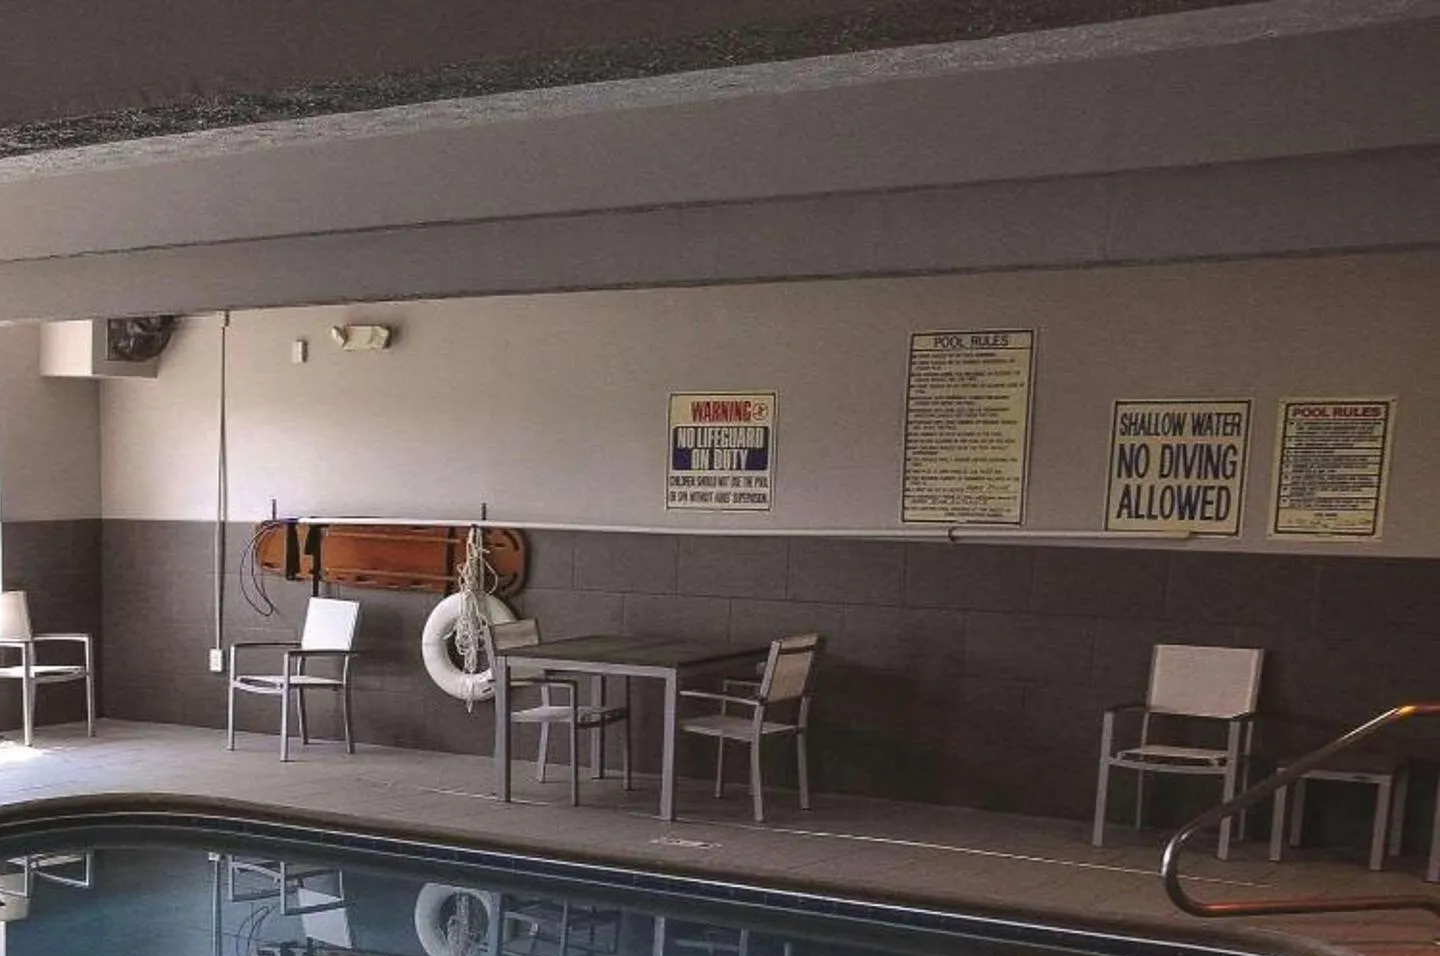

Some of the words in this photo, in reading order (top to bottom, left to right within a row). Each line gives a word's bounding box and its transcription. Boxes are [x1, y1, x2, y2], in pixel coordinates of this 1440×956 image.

[934, 336, 965, 349] POOL
[970, 335, 1009, 347] RULES
[691, 400, 752, 422] WARNING
[1292, 407, 1330, 418] POOL
[1333, 407, 1381, 418] RULES
[1119, 412, 1188, 437] SHALLOW
[1191, 412, 1242, 437] WATER
[677, 427, 695, 448] NO
[697, 427, 765, 449] LIFEGUARD
[691, 448, 710, 469] ON
[713, 448, 748, 469] DUTY
[1117, 443, 1151, 479] NO
[1158, 443, 1239, 480] DIVING
[1116, 484, 1232, 522] ALLOWED
